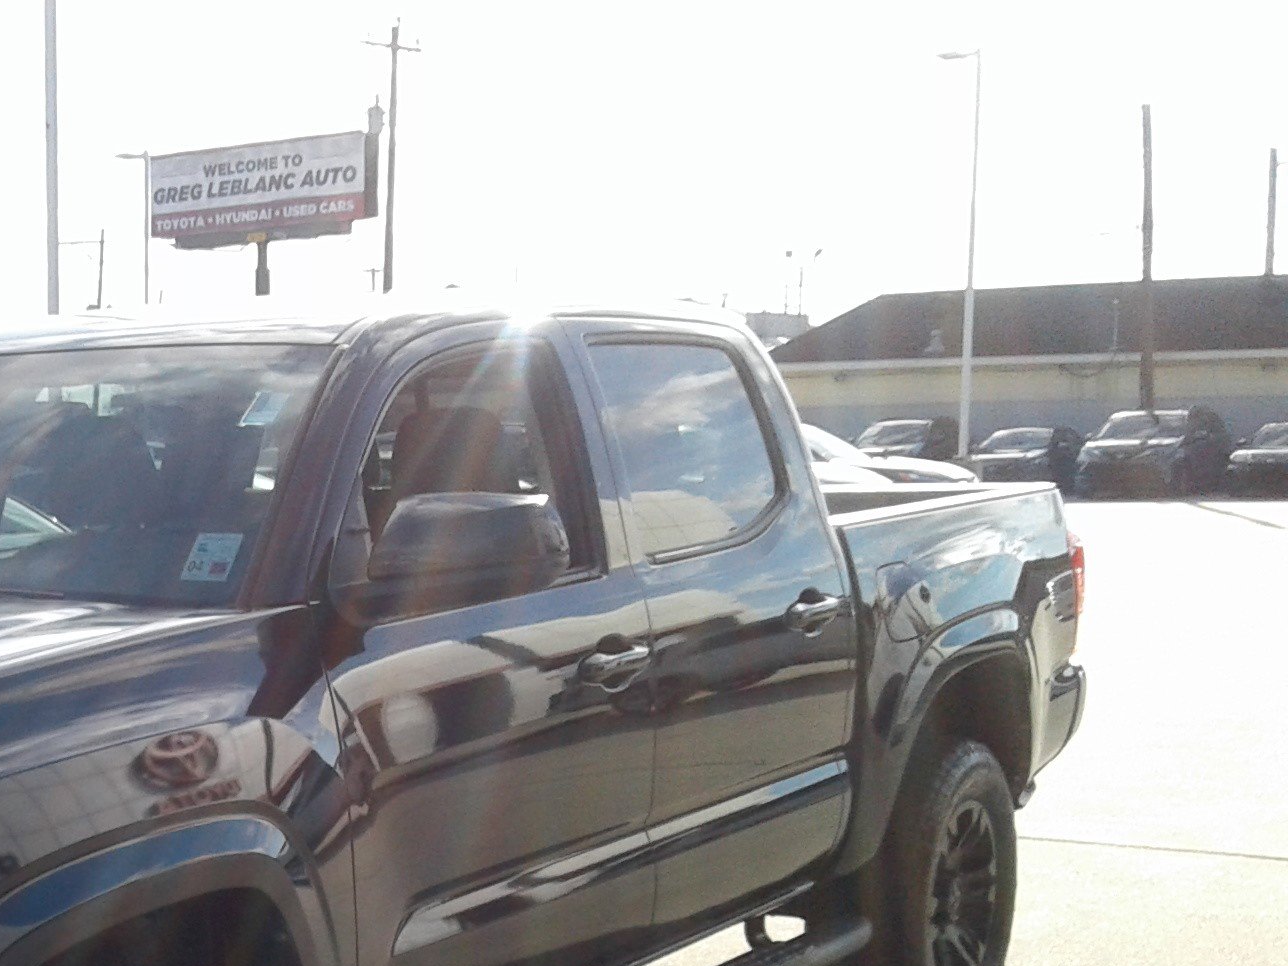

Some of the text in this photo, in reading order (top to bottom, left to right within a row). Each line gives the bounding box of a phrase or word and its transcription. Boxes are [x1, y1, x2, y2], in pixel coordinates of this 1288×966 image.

[202, 153, 304, 179] WELCOME TO
[153, 165, 358, 205] GREG LEBLANC AUTO
[155, 199, 355, 232] TOYOTA HYUNDAI USED CARS
